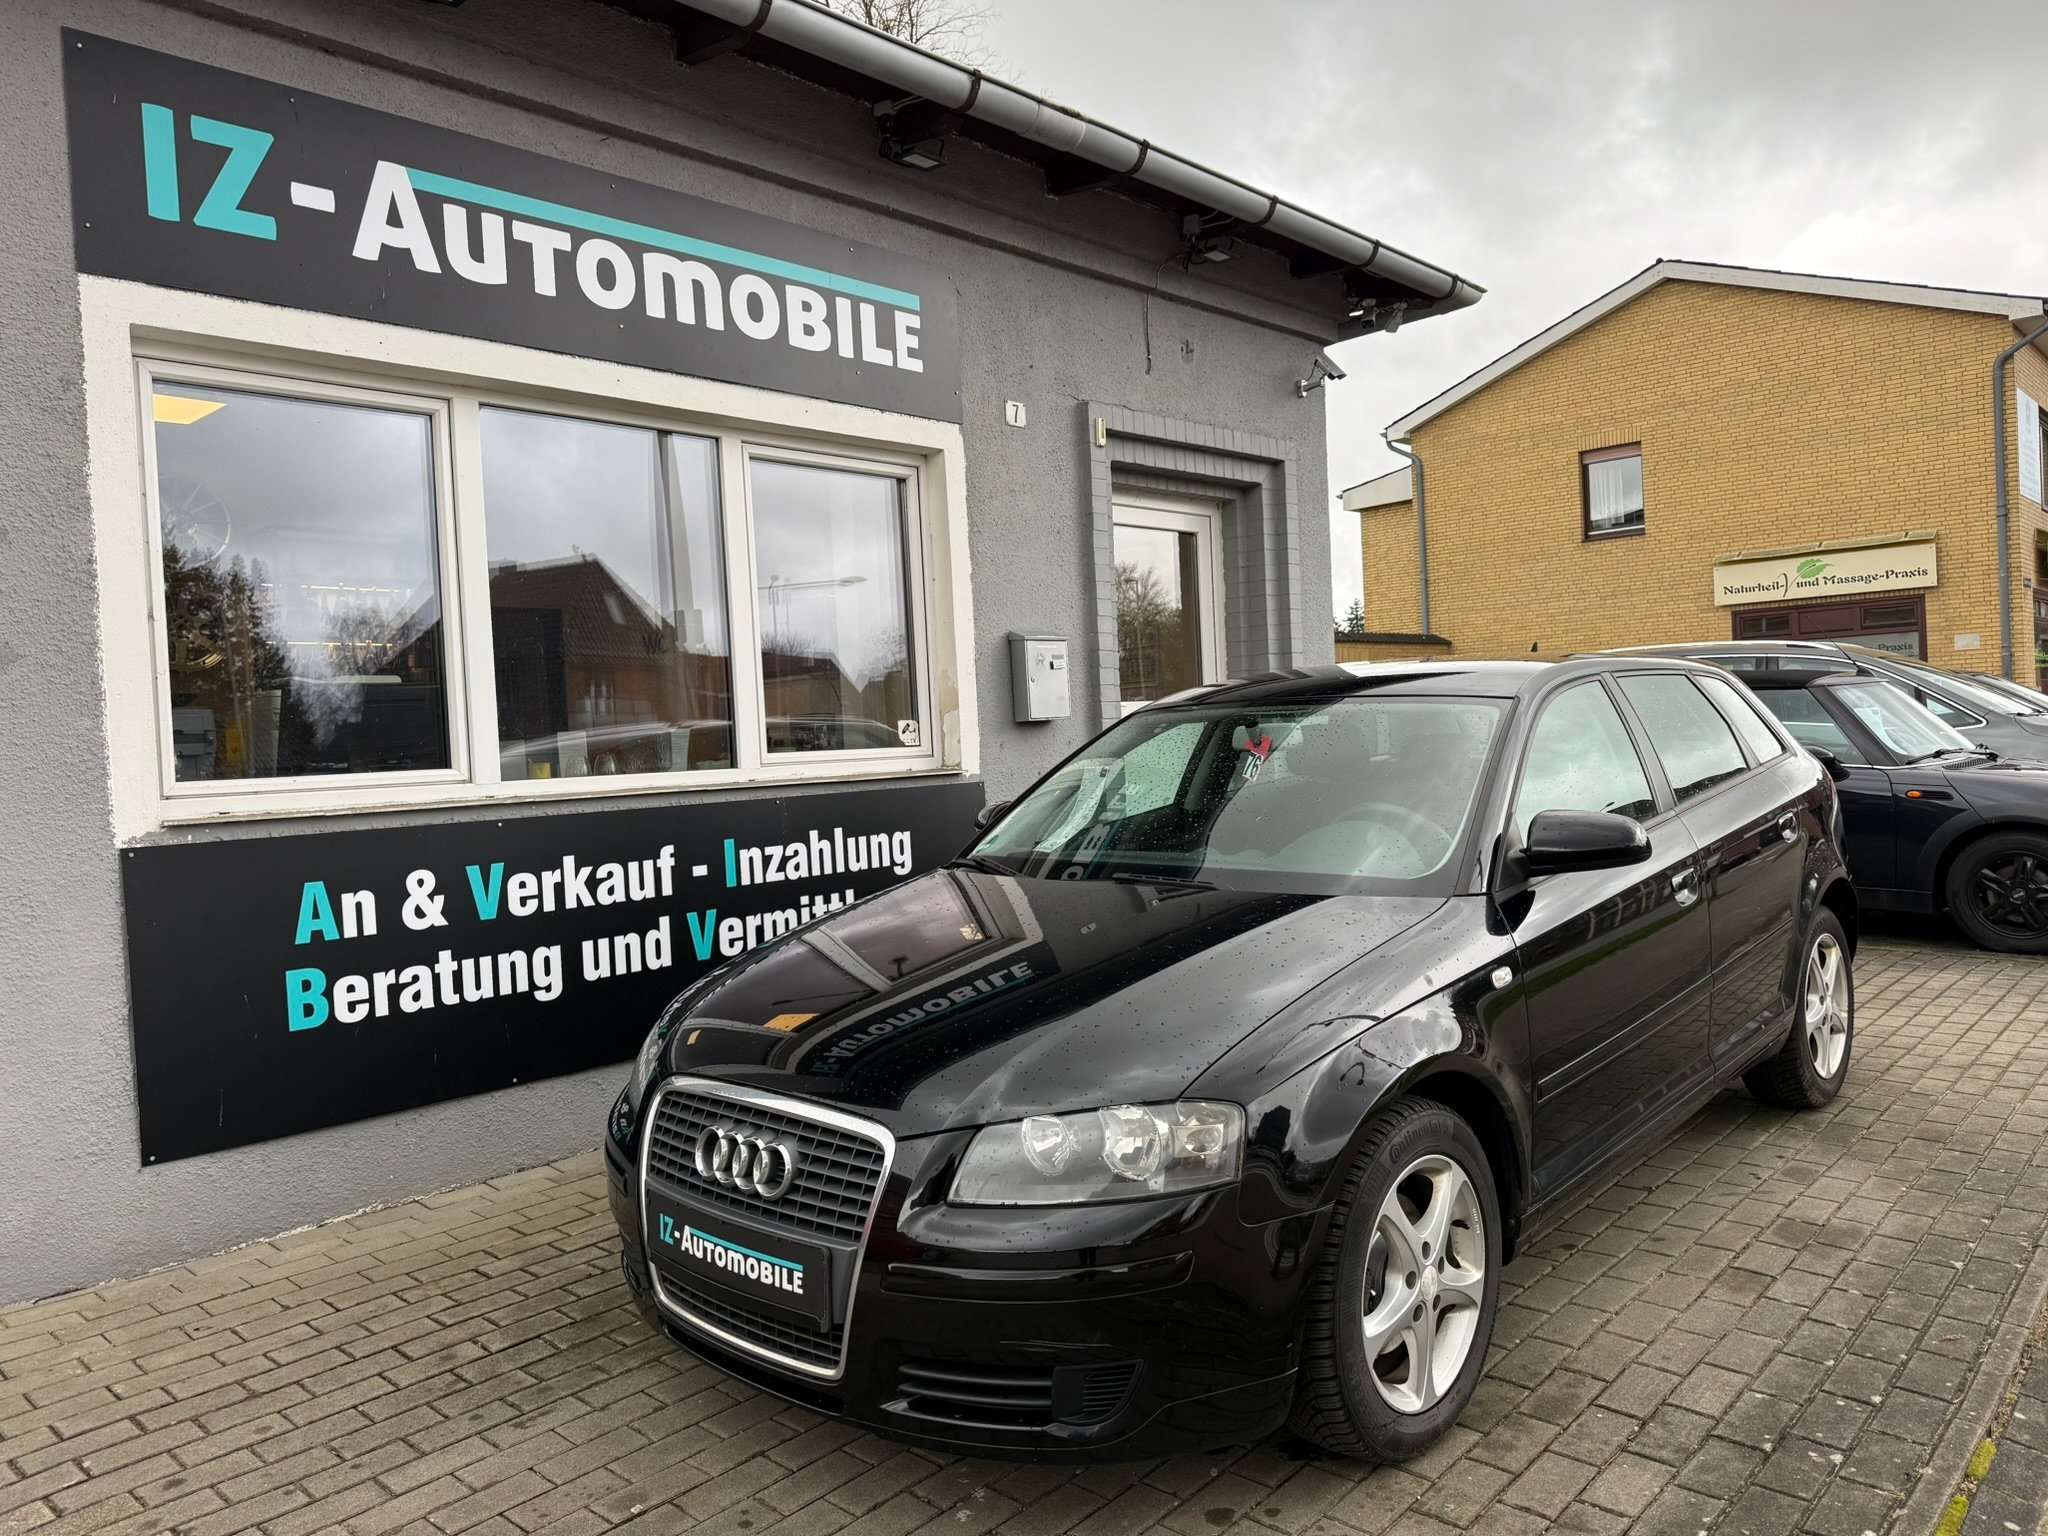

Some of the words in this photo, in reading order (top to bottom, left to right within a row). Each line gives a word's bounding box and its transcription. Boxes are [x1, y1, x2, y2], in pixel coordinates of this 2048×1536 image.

[1011, 402, 1020, 424] 7
[1796, 577, 1820, 588] und
[1822, 567, 1929, 585] Massage-Praxis
[294, 880, 378, 945] An
[401, 869, 450, 931] &
[464, 845, 676, 921] Verkauf
[723, 827, 913, 888] Inzahlung
[285, 944, 564, 1033] Beratung
[581, 915, 673, 983] und
